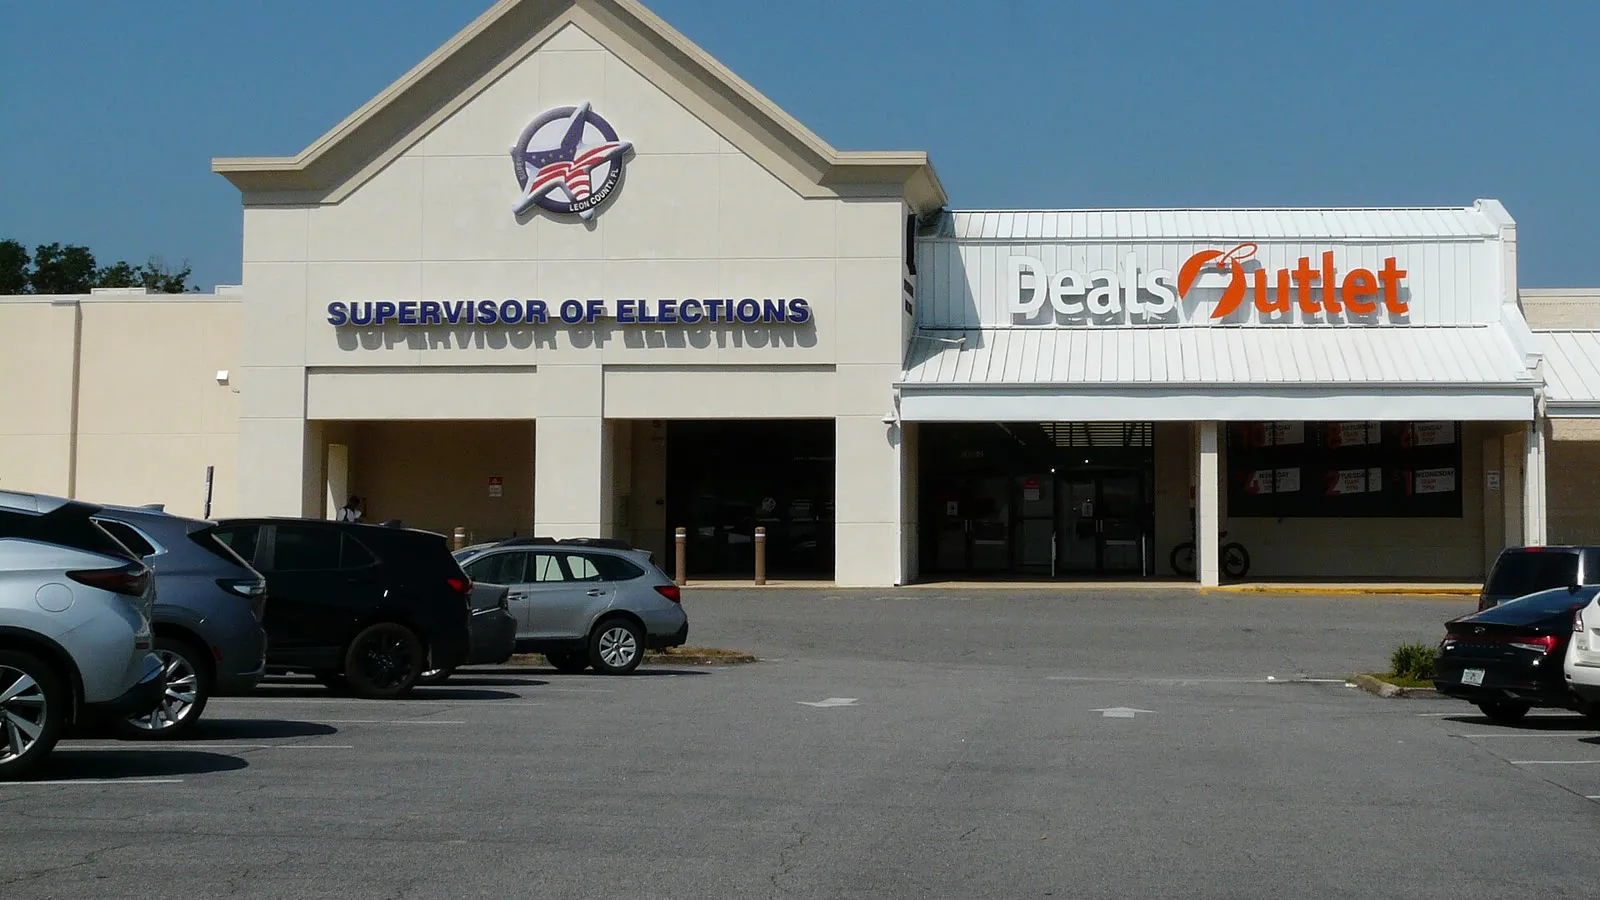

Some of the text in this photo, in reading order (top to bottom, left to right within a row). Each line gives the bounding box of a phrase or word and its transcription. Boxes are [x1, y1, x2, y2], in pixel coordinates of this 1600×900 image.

[569, 200, 590, 212] LEON
[610, 168, 619, 178] FL
[1006, 251, 1177, 316] Deals
[326, 297, 811, 326] SUPERVISOR OF ELECTIONS
